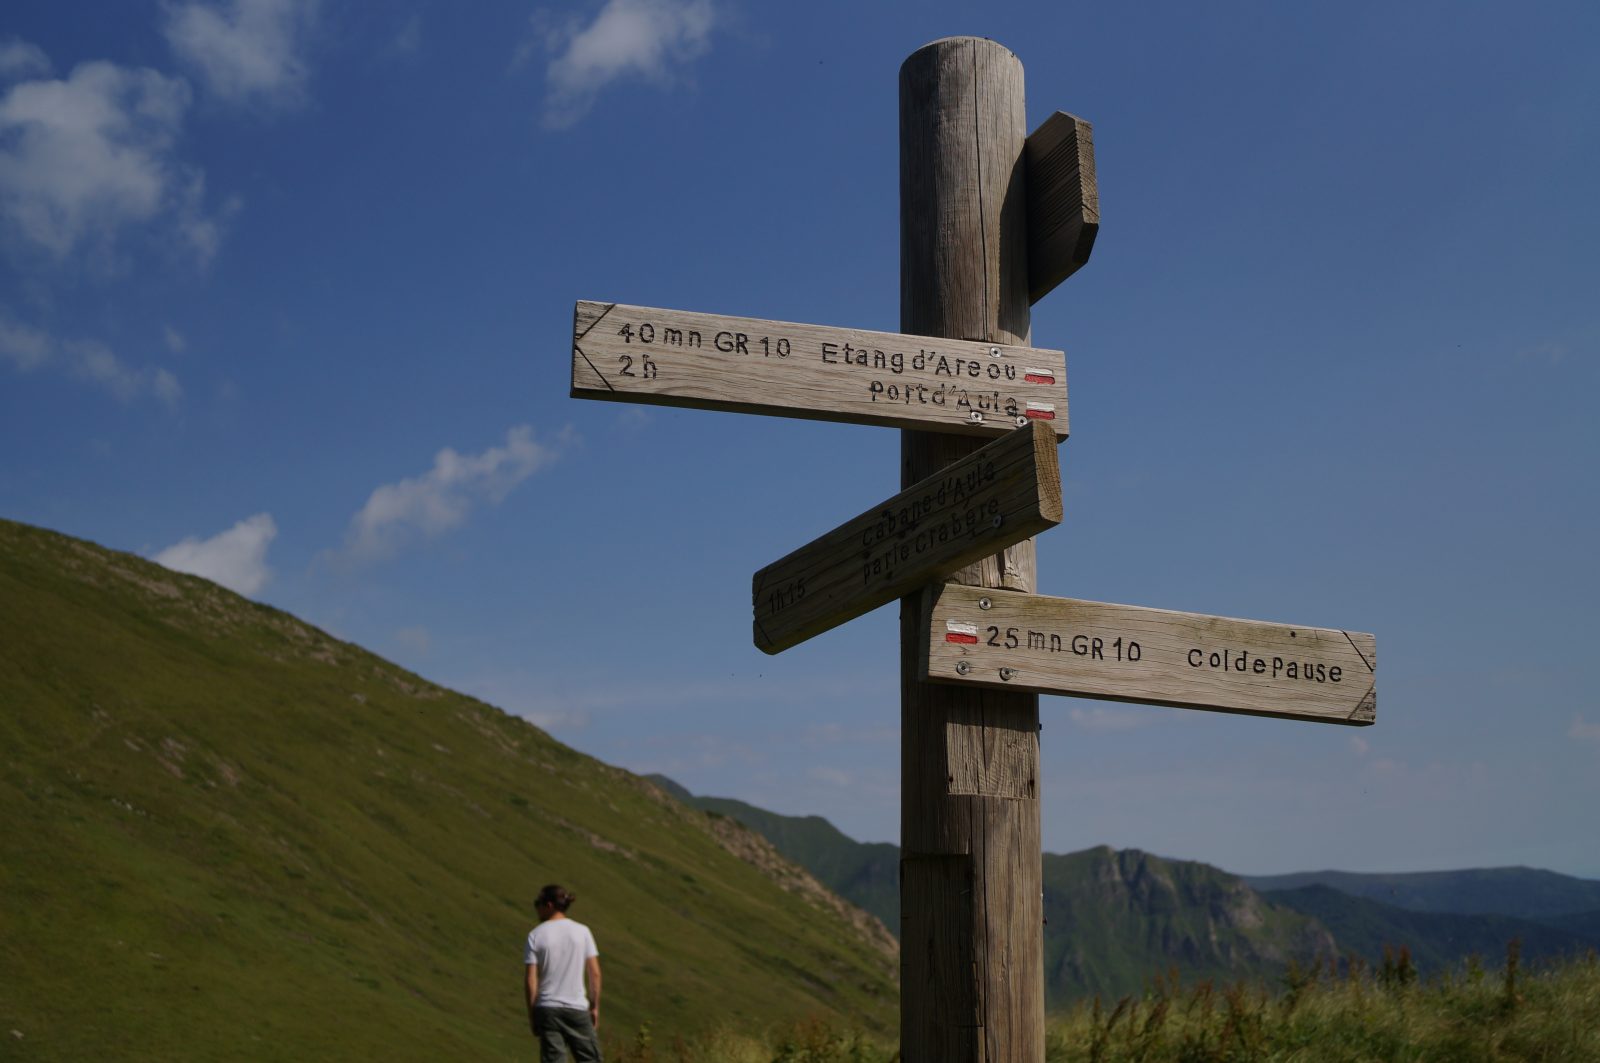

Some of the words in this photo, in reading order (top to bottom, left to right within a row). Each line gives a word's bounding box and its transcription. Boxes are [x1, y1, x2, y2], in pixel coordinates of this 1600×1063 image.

[617, 323, 655, 344] 40
[663, 326, 702, 348] mn
[714, 331, 749, 355] GR
[759, 336, 791, 359] 10
[821, 342, 904, 374] Etang
[986, 625, 1020, 649] 25
[1027, 629, 1062, 653] mn
[1071, 634, 1104, 661] GR
[1112, 636, 1142, 662] 10
